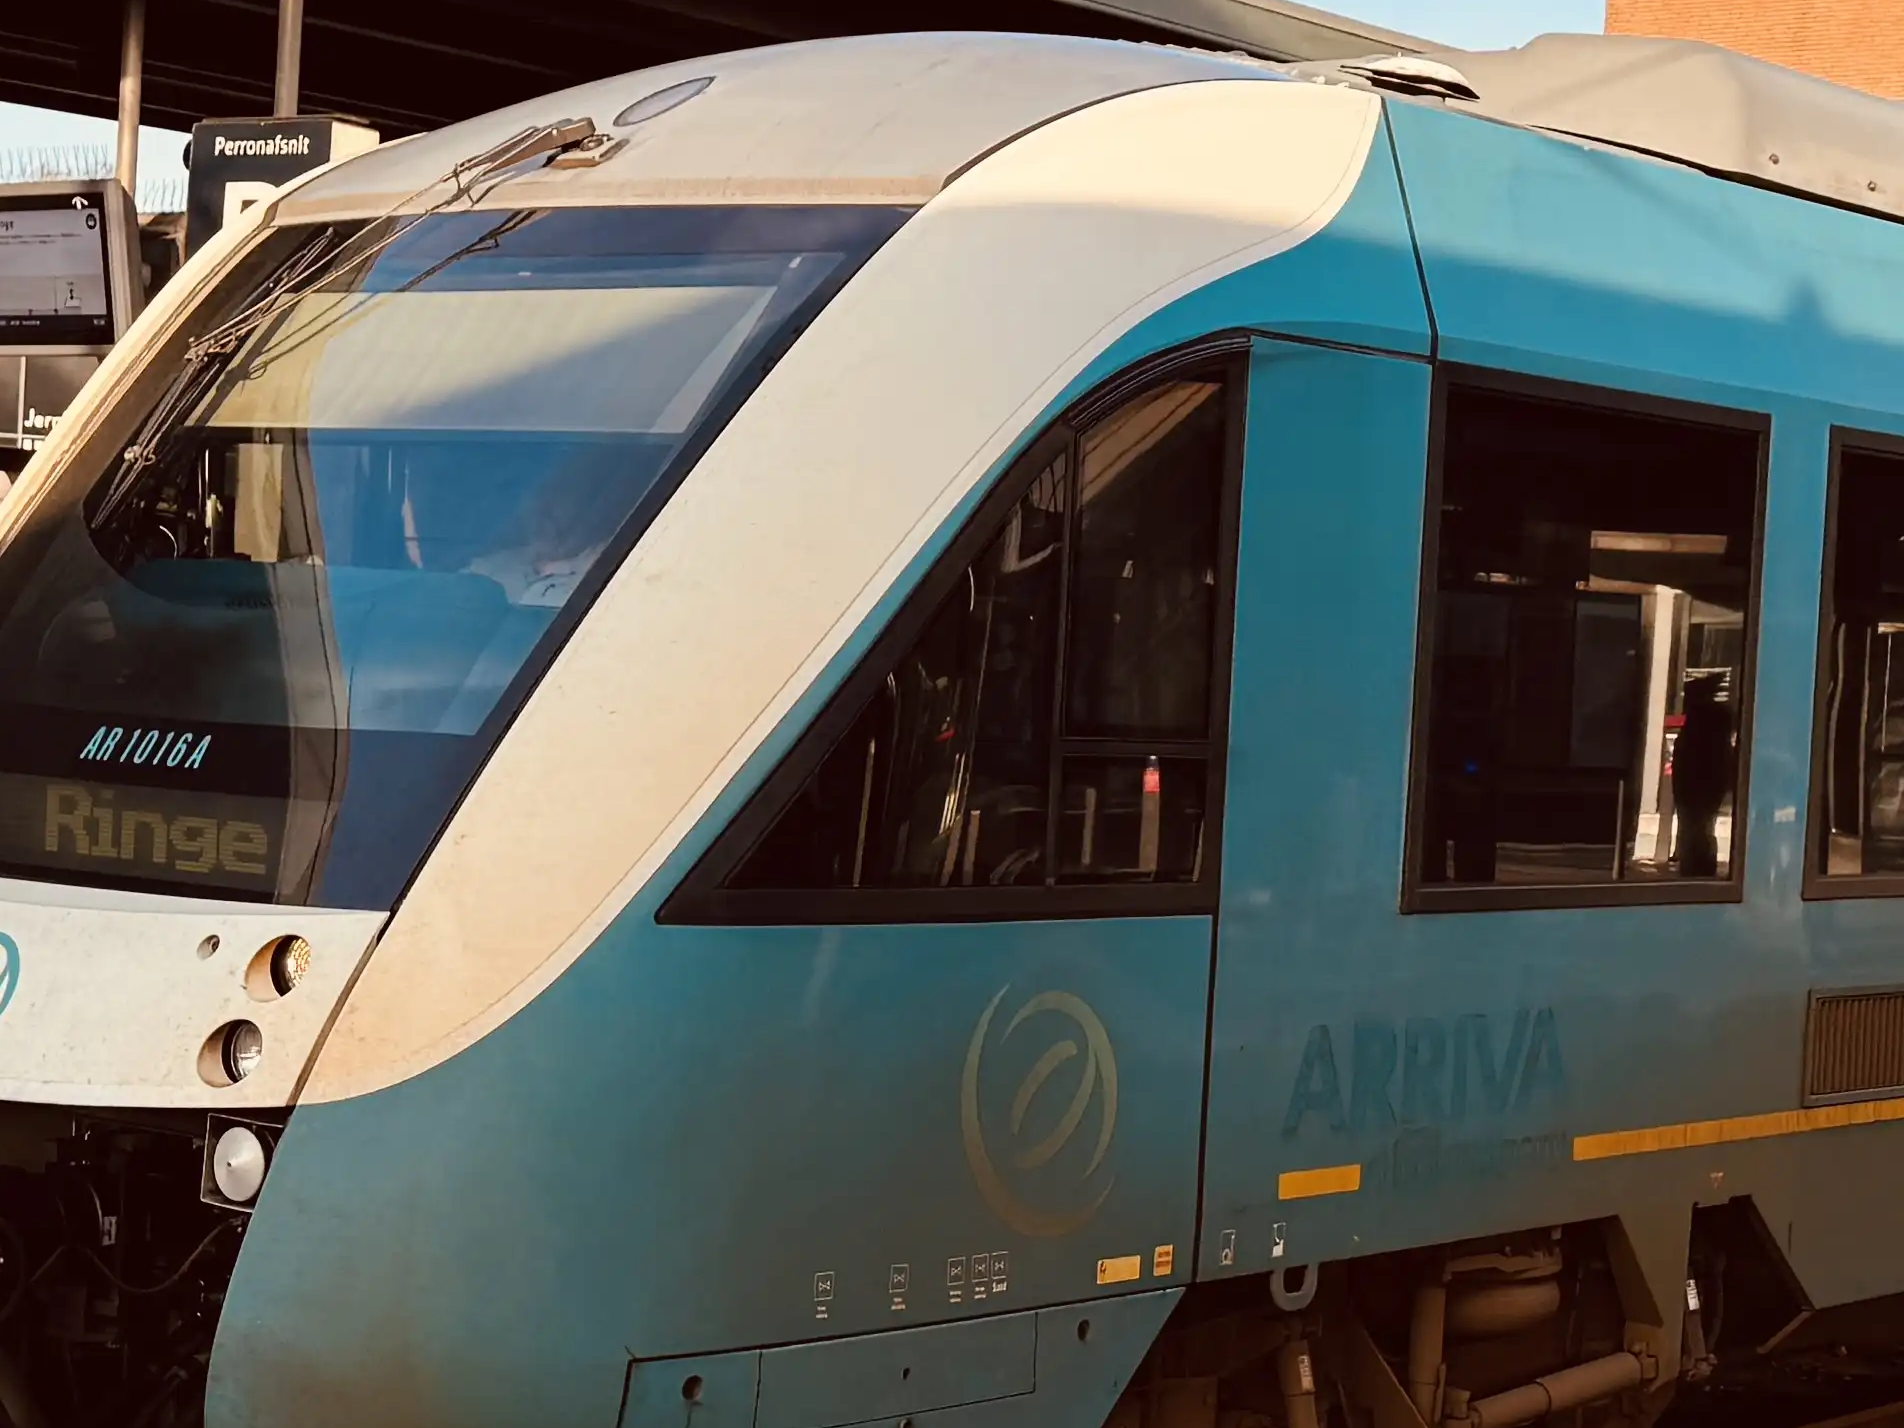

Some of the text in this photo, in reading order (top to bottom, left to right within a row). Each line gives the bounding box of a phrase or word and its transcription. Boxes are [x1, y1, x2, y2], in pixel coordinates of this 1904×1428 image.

[214, 134, 311, 157] Perronafsnit
[44, 783, 268, 876] Ringe
[1281, 1006, 1568, 1139] ARRIVA
